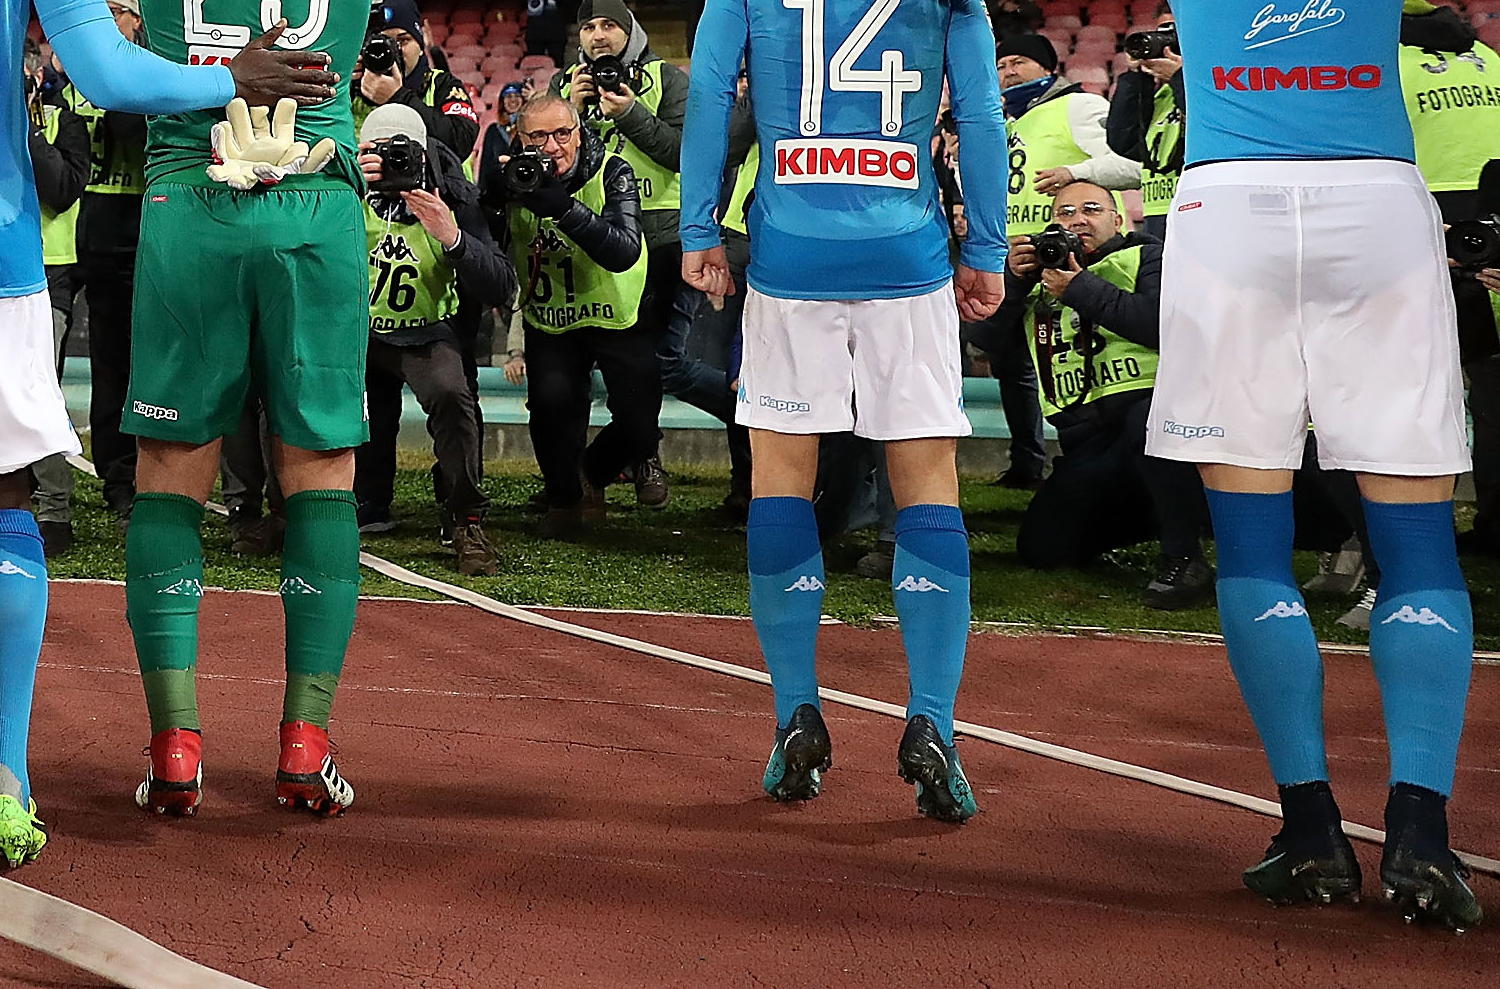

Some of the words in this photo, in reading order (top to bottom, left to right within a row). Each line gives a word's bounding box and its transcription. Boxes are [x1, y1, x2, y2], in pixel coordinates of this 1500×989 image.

[1212, 64, 1382, 91] KIMBO
[777, 147, 916, 180] KIMBO
[1006, 204, 1051, 224] GRAFO
[369, 256, 419, 313] 76
[529, 303, 614, 328] OTOGRAFO
[1038, 323, 1047, 345] EOS
[1056, 357, 1141, 398] TOGRAFO
[133, 401, 178, 421] Kappa
[759, 395, 810, 412] Kappa
[1163, 420, 1225, 439] Kappa
